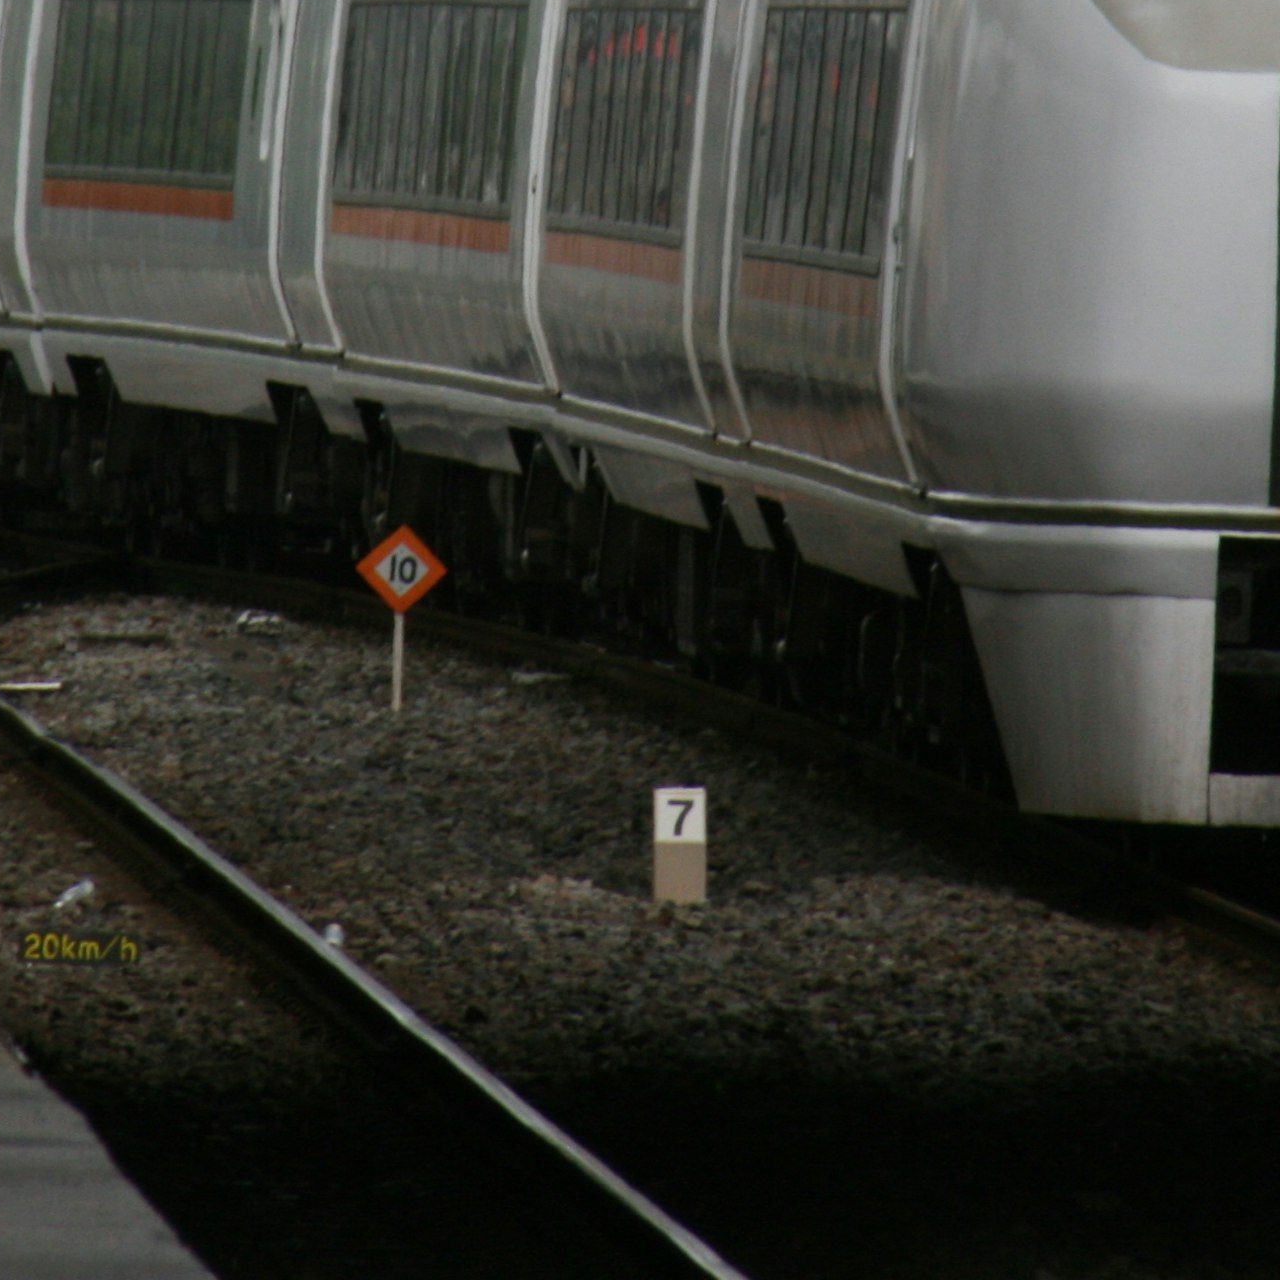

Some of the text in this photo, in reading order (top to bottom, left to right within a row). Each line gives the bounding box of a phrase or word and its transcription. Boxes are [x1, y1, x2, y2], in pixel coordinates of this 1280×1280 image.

[389, 555, 417, 584] 10
[667, 799, 694, 836] 7
[24, 932, 138, 961] 20km/h
